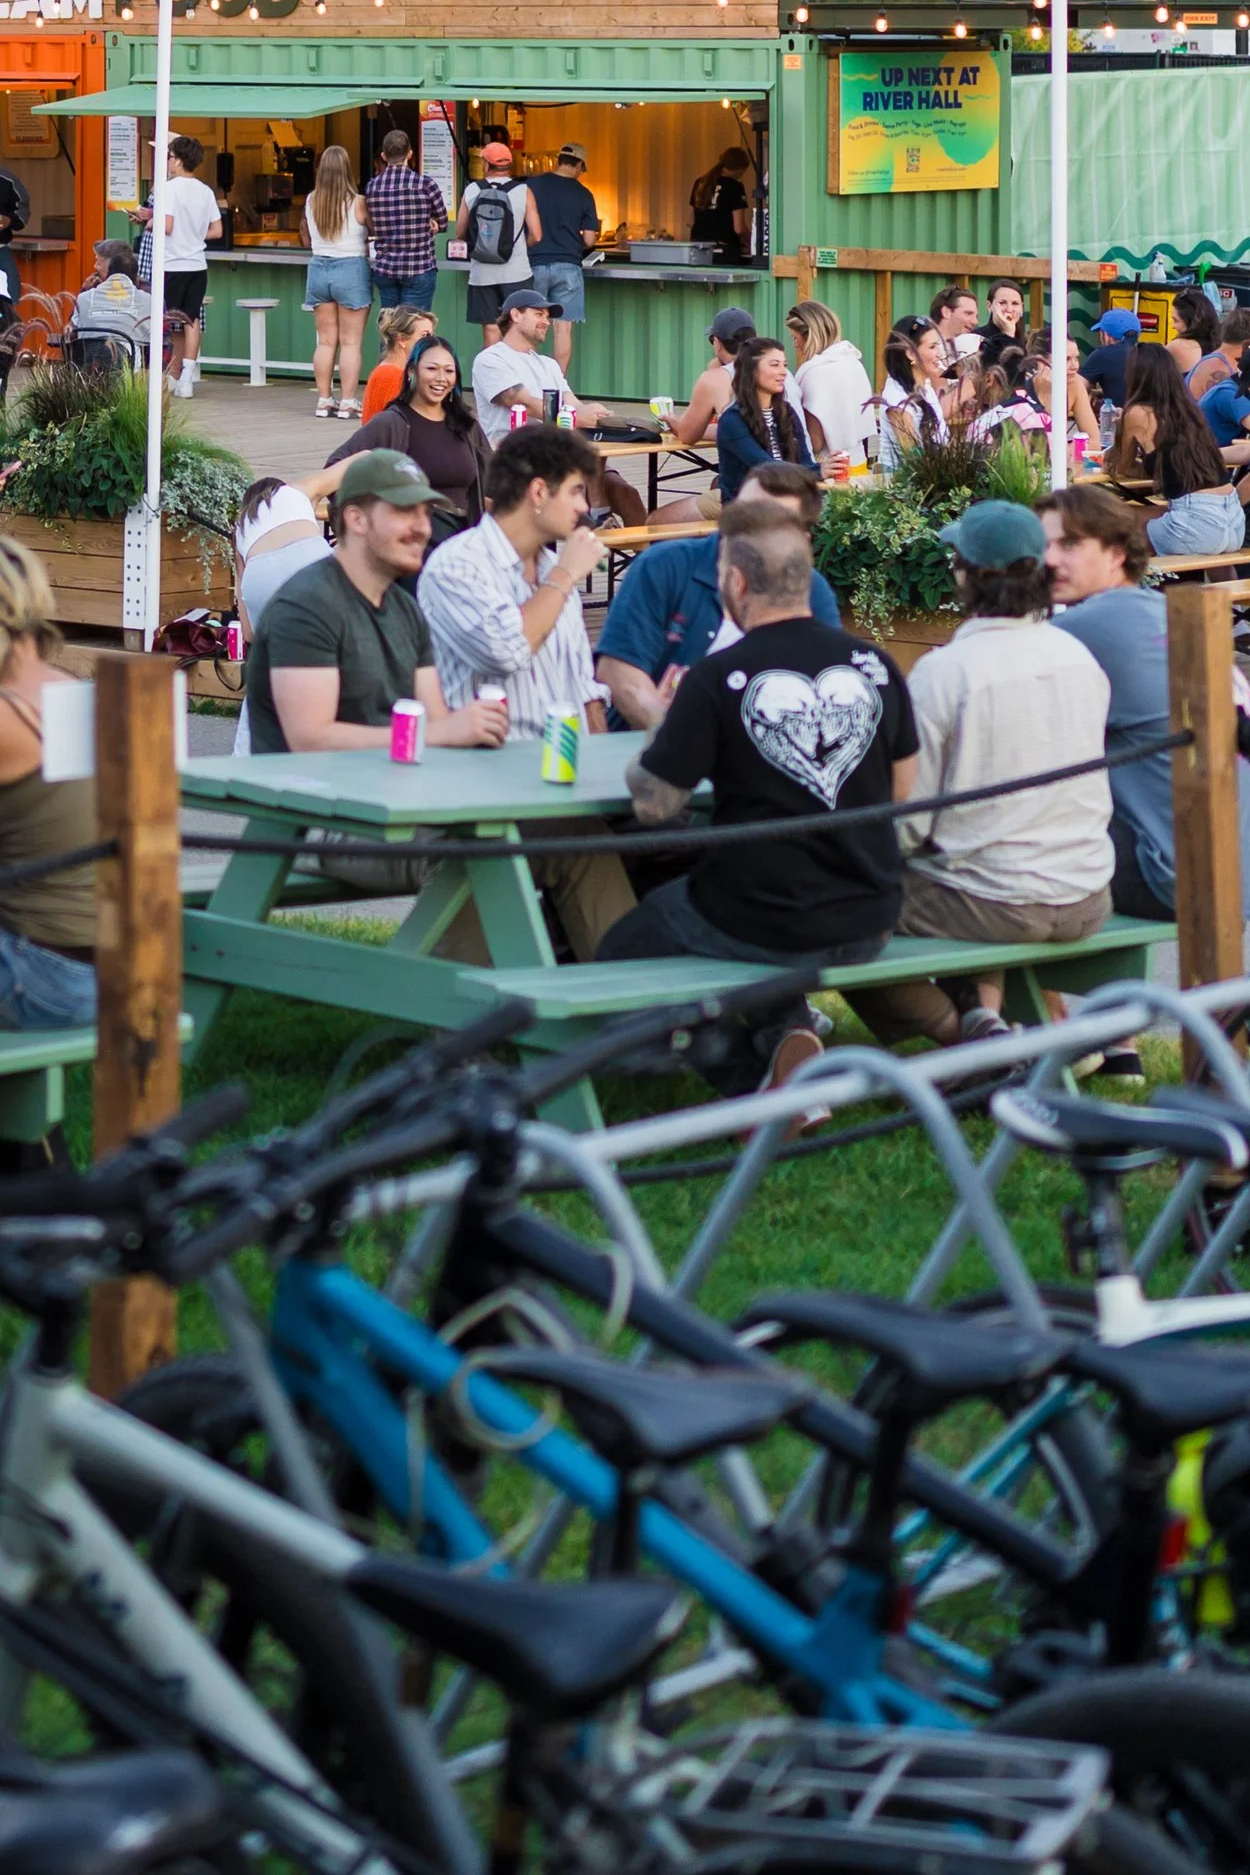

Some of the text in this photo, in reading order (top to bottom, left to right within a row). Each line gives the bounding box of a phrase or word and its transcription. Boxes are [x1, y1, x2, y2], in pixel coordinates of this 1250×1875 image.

[880, 66, 981, 87] UP NEXT AT
[862, 90, 963, 112] RIVER HALL
